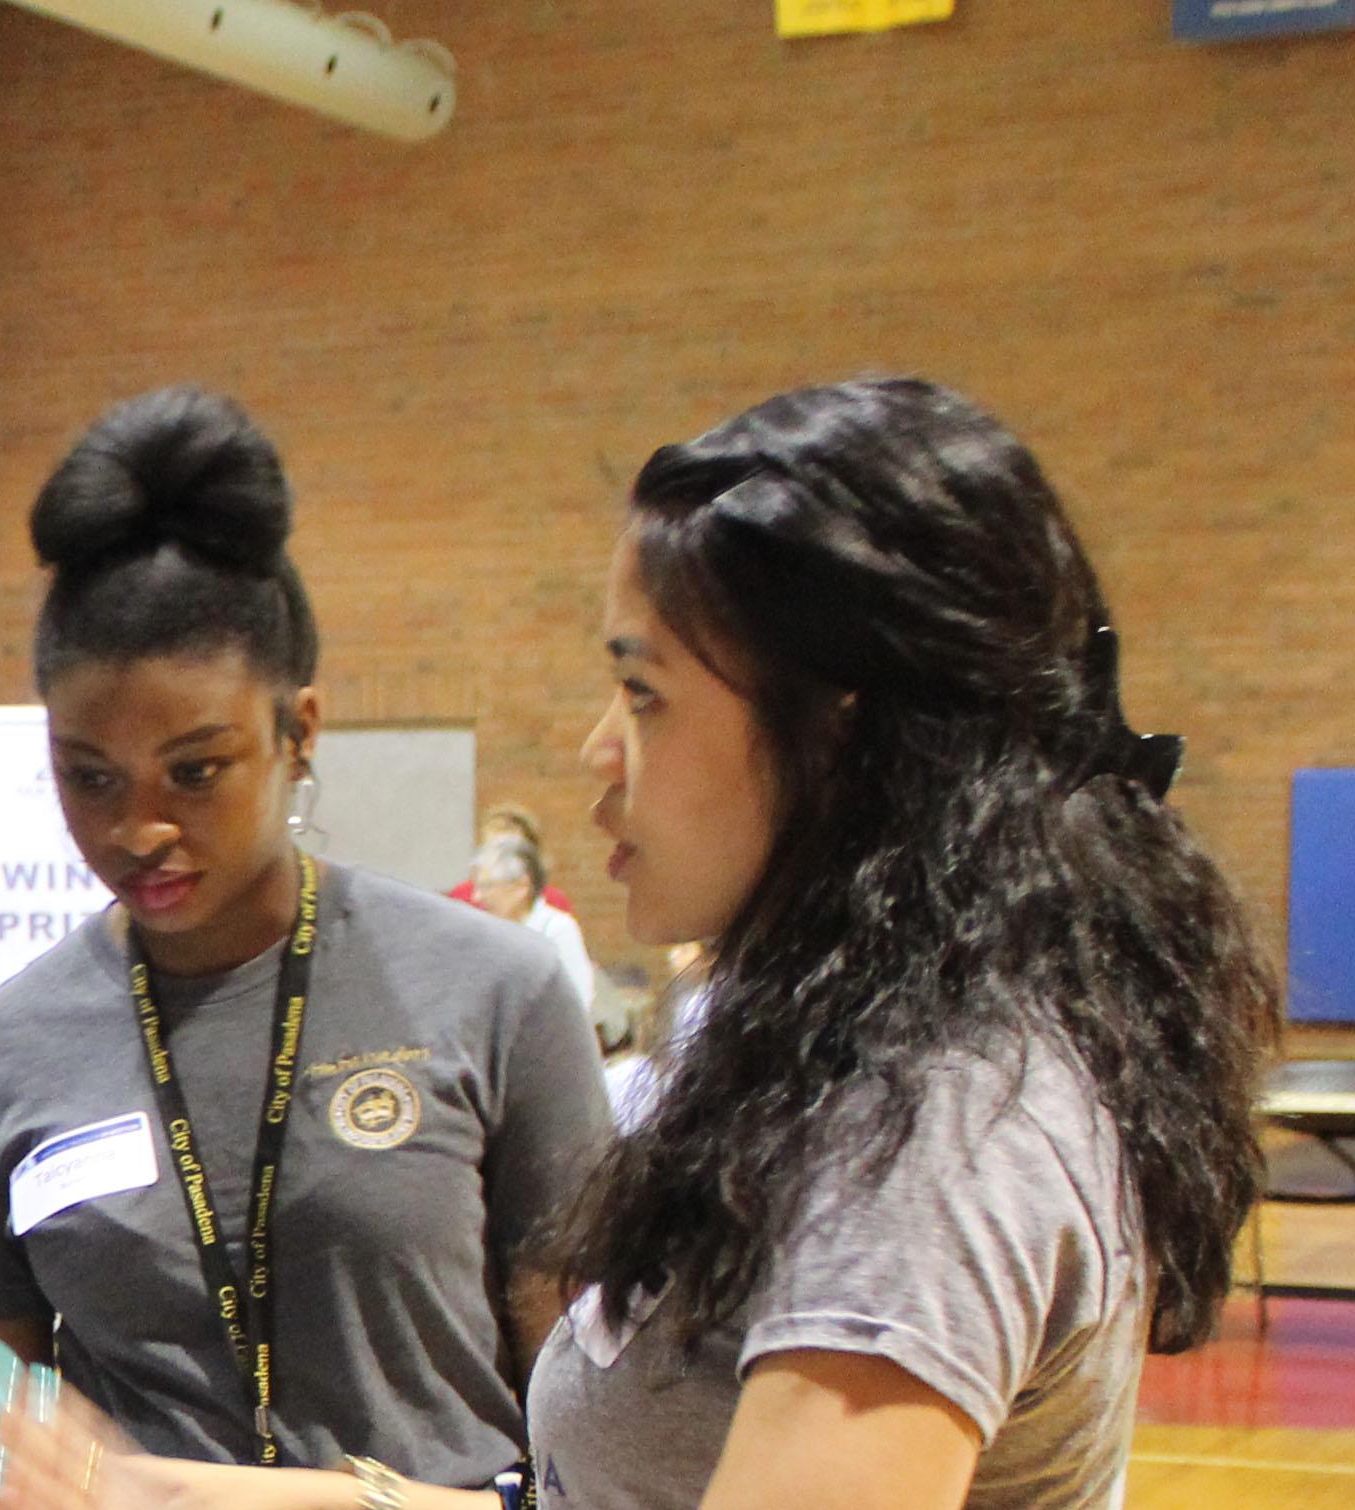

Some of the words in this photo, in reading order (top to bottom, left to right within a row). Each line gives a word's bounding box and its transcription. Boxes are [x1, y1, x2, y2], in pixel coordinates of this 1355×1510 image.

[2, 862, 96, 891] WIN
[292, 919, 314, 956] City
[131, 962, 149, 995] City
[138, 997, 157, 1014] of
[277, 996, 305, 1061] Pasadena
[143, 1015, 172, 1085] Pasadena
[273, 1060, 292, 1084] of
[266, 1085, 289, 1125] City
[170, 1117, 191, 1153] City
[179, 1153, 202, 1173] of
[184, 1172, 217, 1247] Pasadena
[252, 1163, 275, 1240] Pasadena
[251, 1240, 268, 1264] of
[248, 1264, 268, 1299] City
[218, 1284, 238, 1320] City
